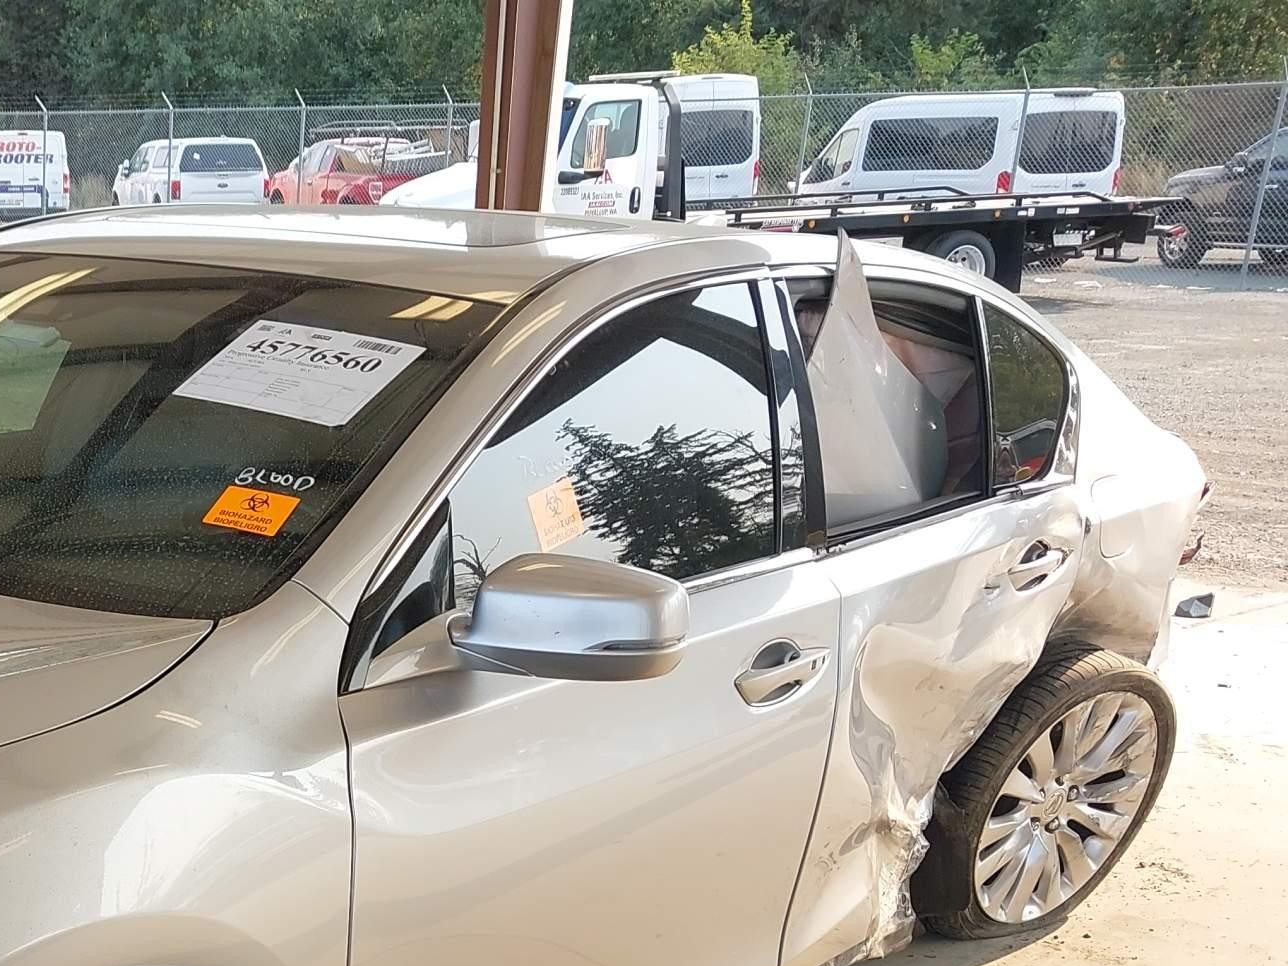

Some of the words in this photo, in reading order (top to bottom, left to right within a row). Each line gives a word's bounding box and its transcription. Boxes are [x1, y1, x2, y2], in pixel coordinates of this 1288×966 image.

[247, 339, 383, 373] 45776560
[234, 467, 315, 491] BLOOD
[213, 516, 268, 533] BIOPELIGRO
[219, 509, 273, 526] BIOHAZARD
